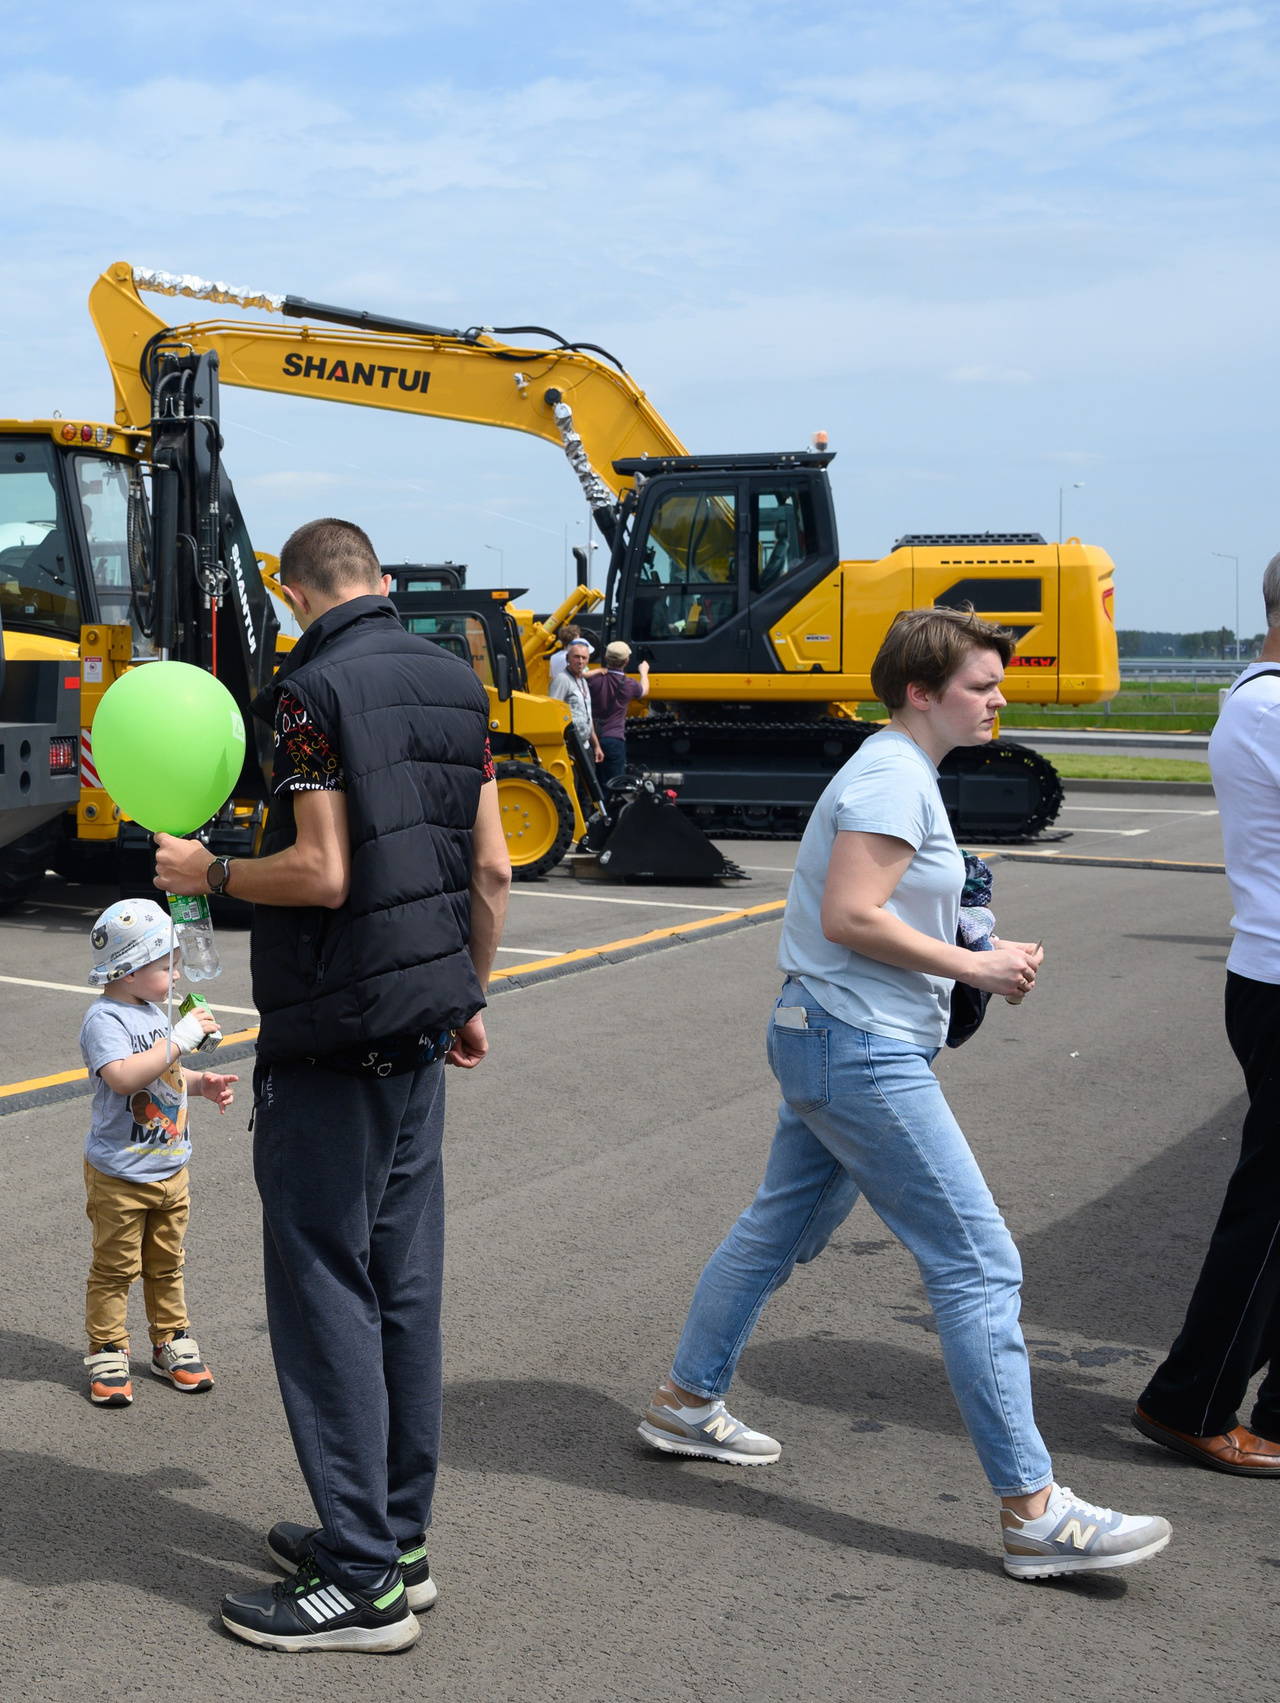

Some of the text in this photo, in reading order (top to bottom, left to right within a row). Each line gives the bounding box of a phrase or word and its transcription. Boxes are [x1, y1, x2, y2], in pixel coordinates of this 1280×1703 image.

[282, 353, 431, 394] SHANTUI
[231, 543, 257, 655] SHANTUI
[703, 1415, 737, 1442] N
[1055, 1518, 1098, 1550] N
